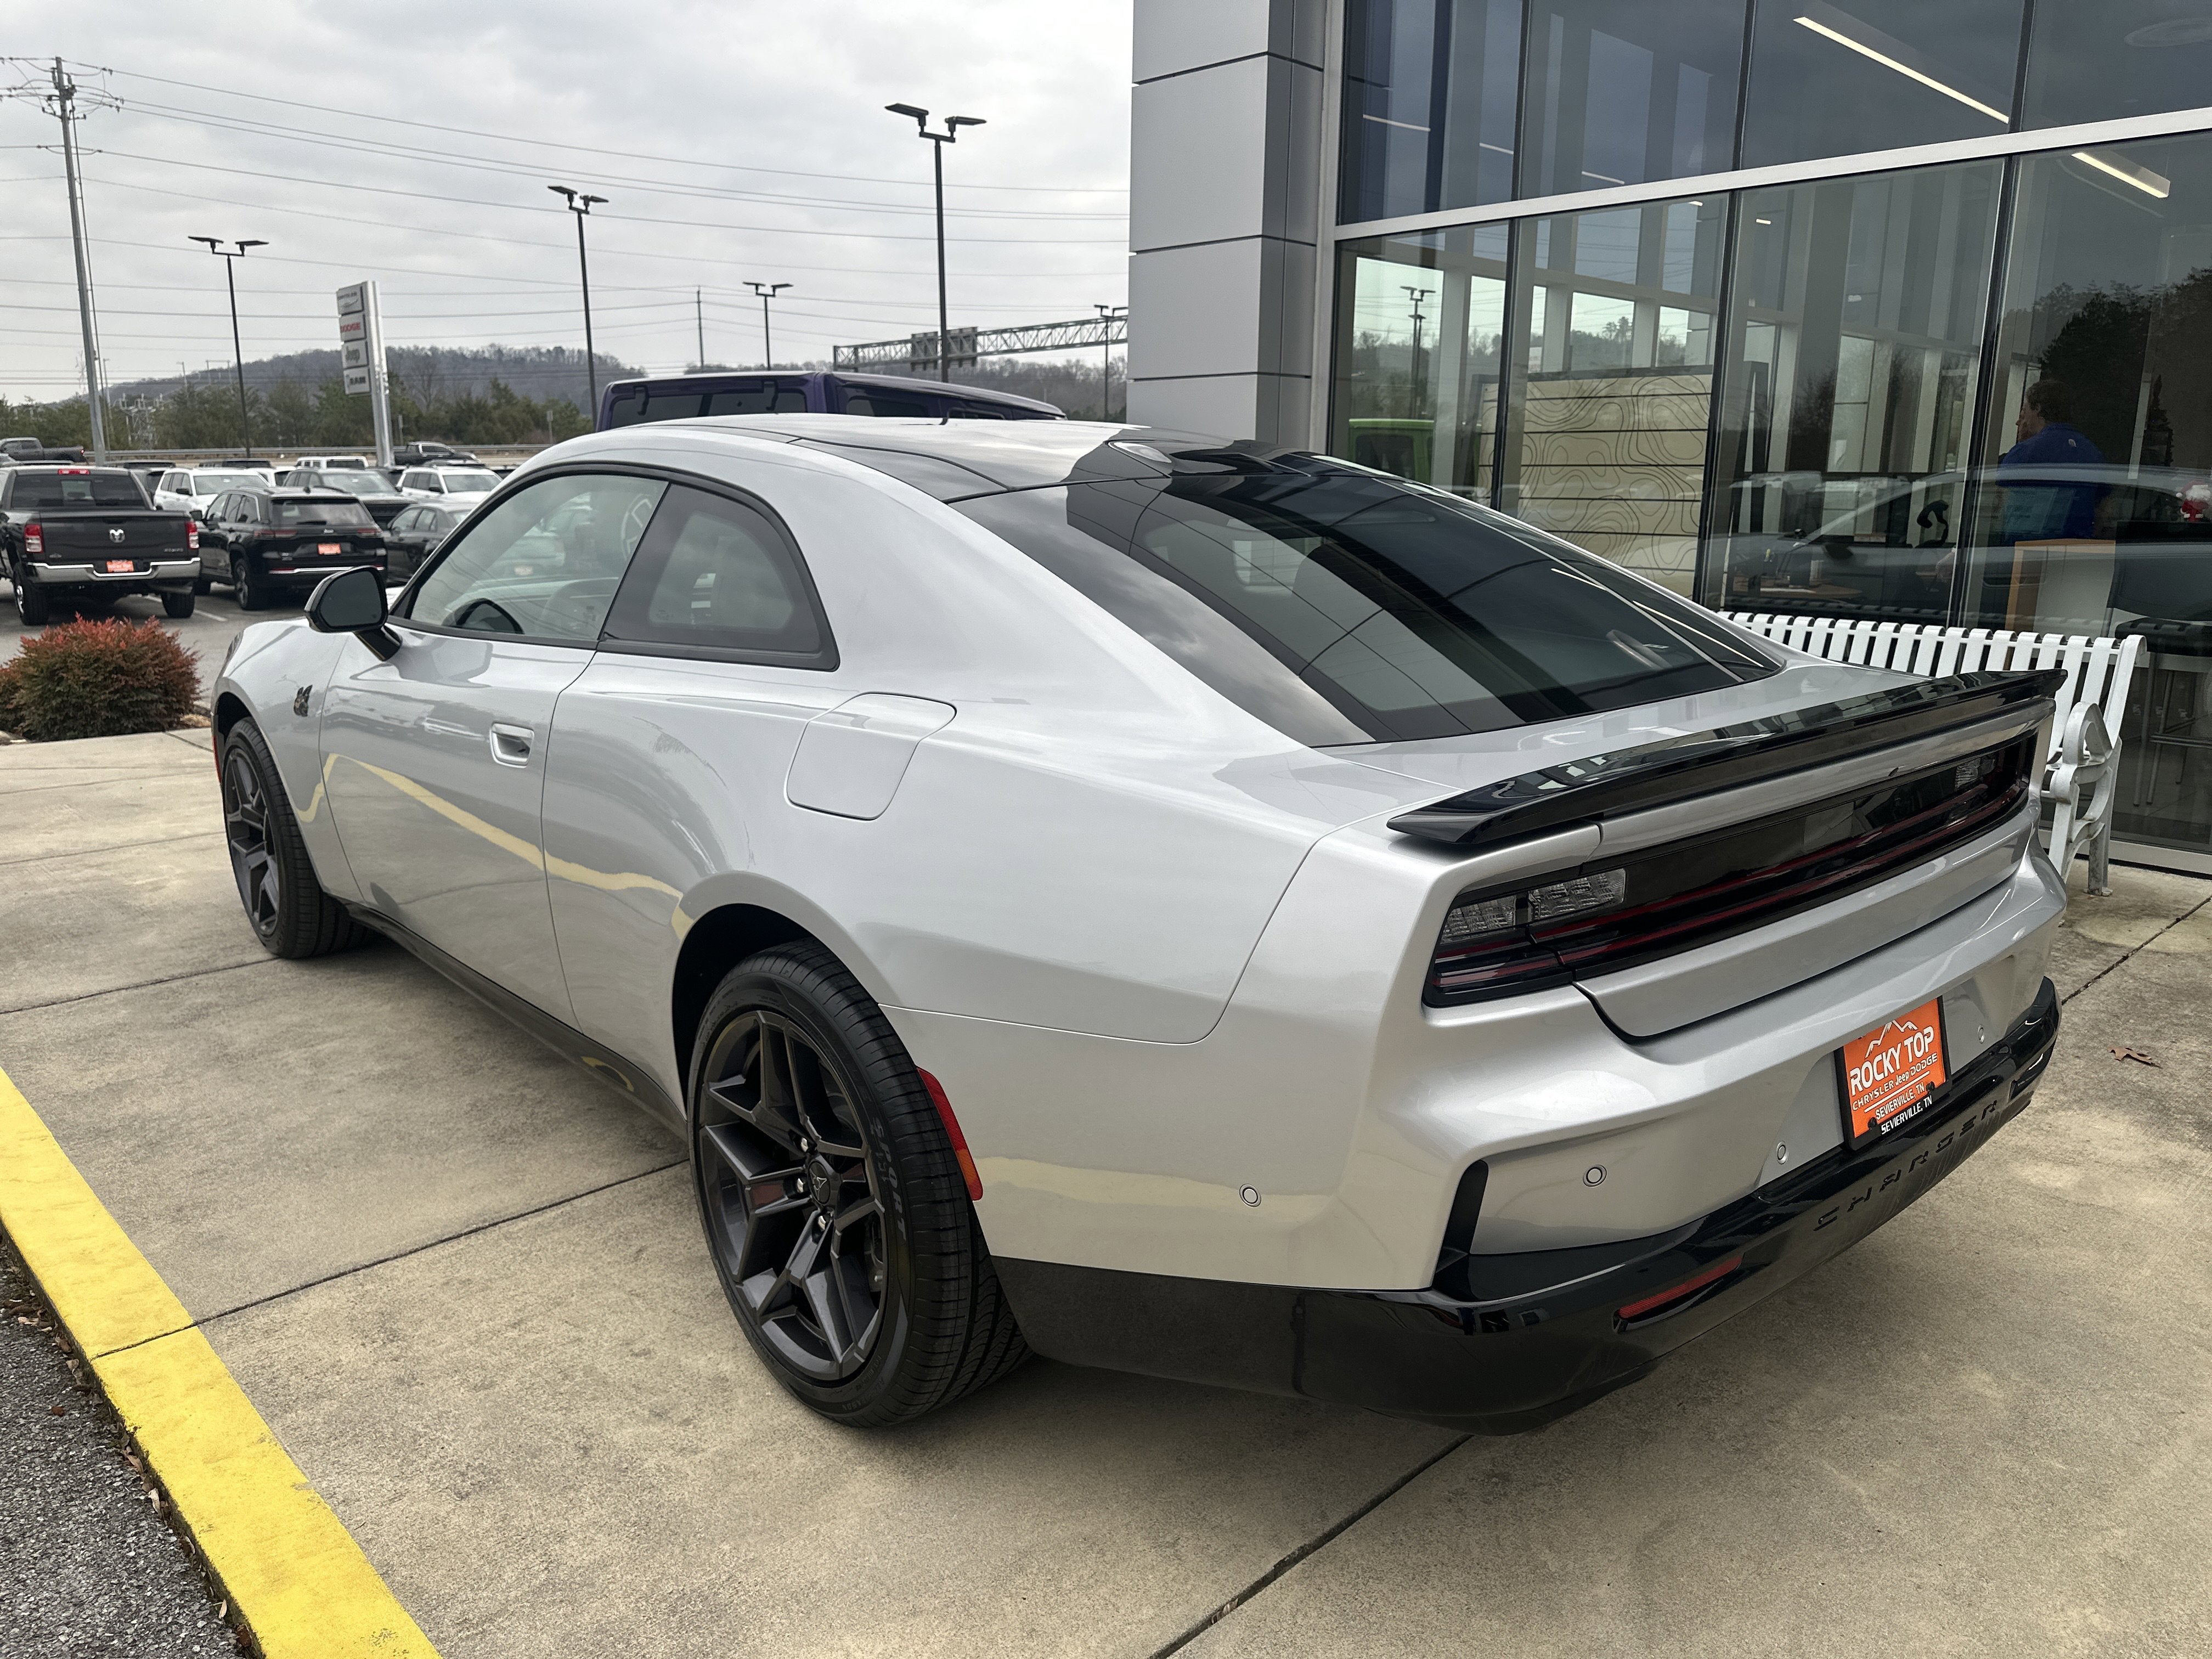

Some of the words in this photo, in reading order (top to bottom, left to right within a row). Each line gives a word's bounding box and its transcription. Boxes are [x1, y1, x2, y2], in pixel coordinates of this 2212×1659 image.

[1850, 1042, 1901, 1097] ROCKY
[1904, 1026, 1934, 1064] TOP
[1852, 1080, 1894, 1111] CHRYSLER
[1895, 1071, 1910, 1087] Jeep
[1910, 1052, 1938, 1077] DODGE
[1875, 1088, 1916, 1121] SEVIERVILLE,
[1916, 1082, 1926, 1096] TN
[1881, 1103, 1923, 1135] SEVIERVILLE,
[1923, 1095, 1933, 1108] TN
[873, 1115, 907, 1241] SPORT
[1812, 1099, 1998, 1232] CHARGER
